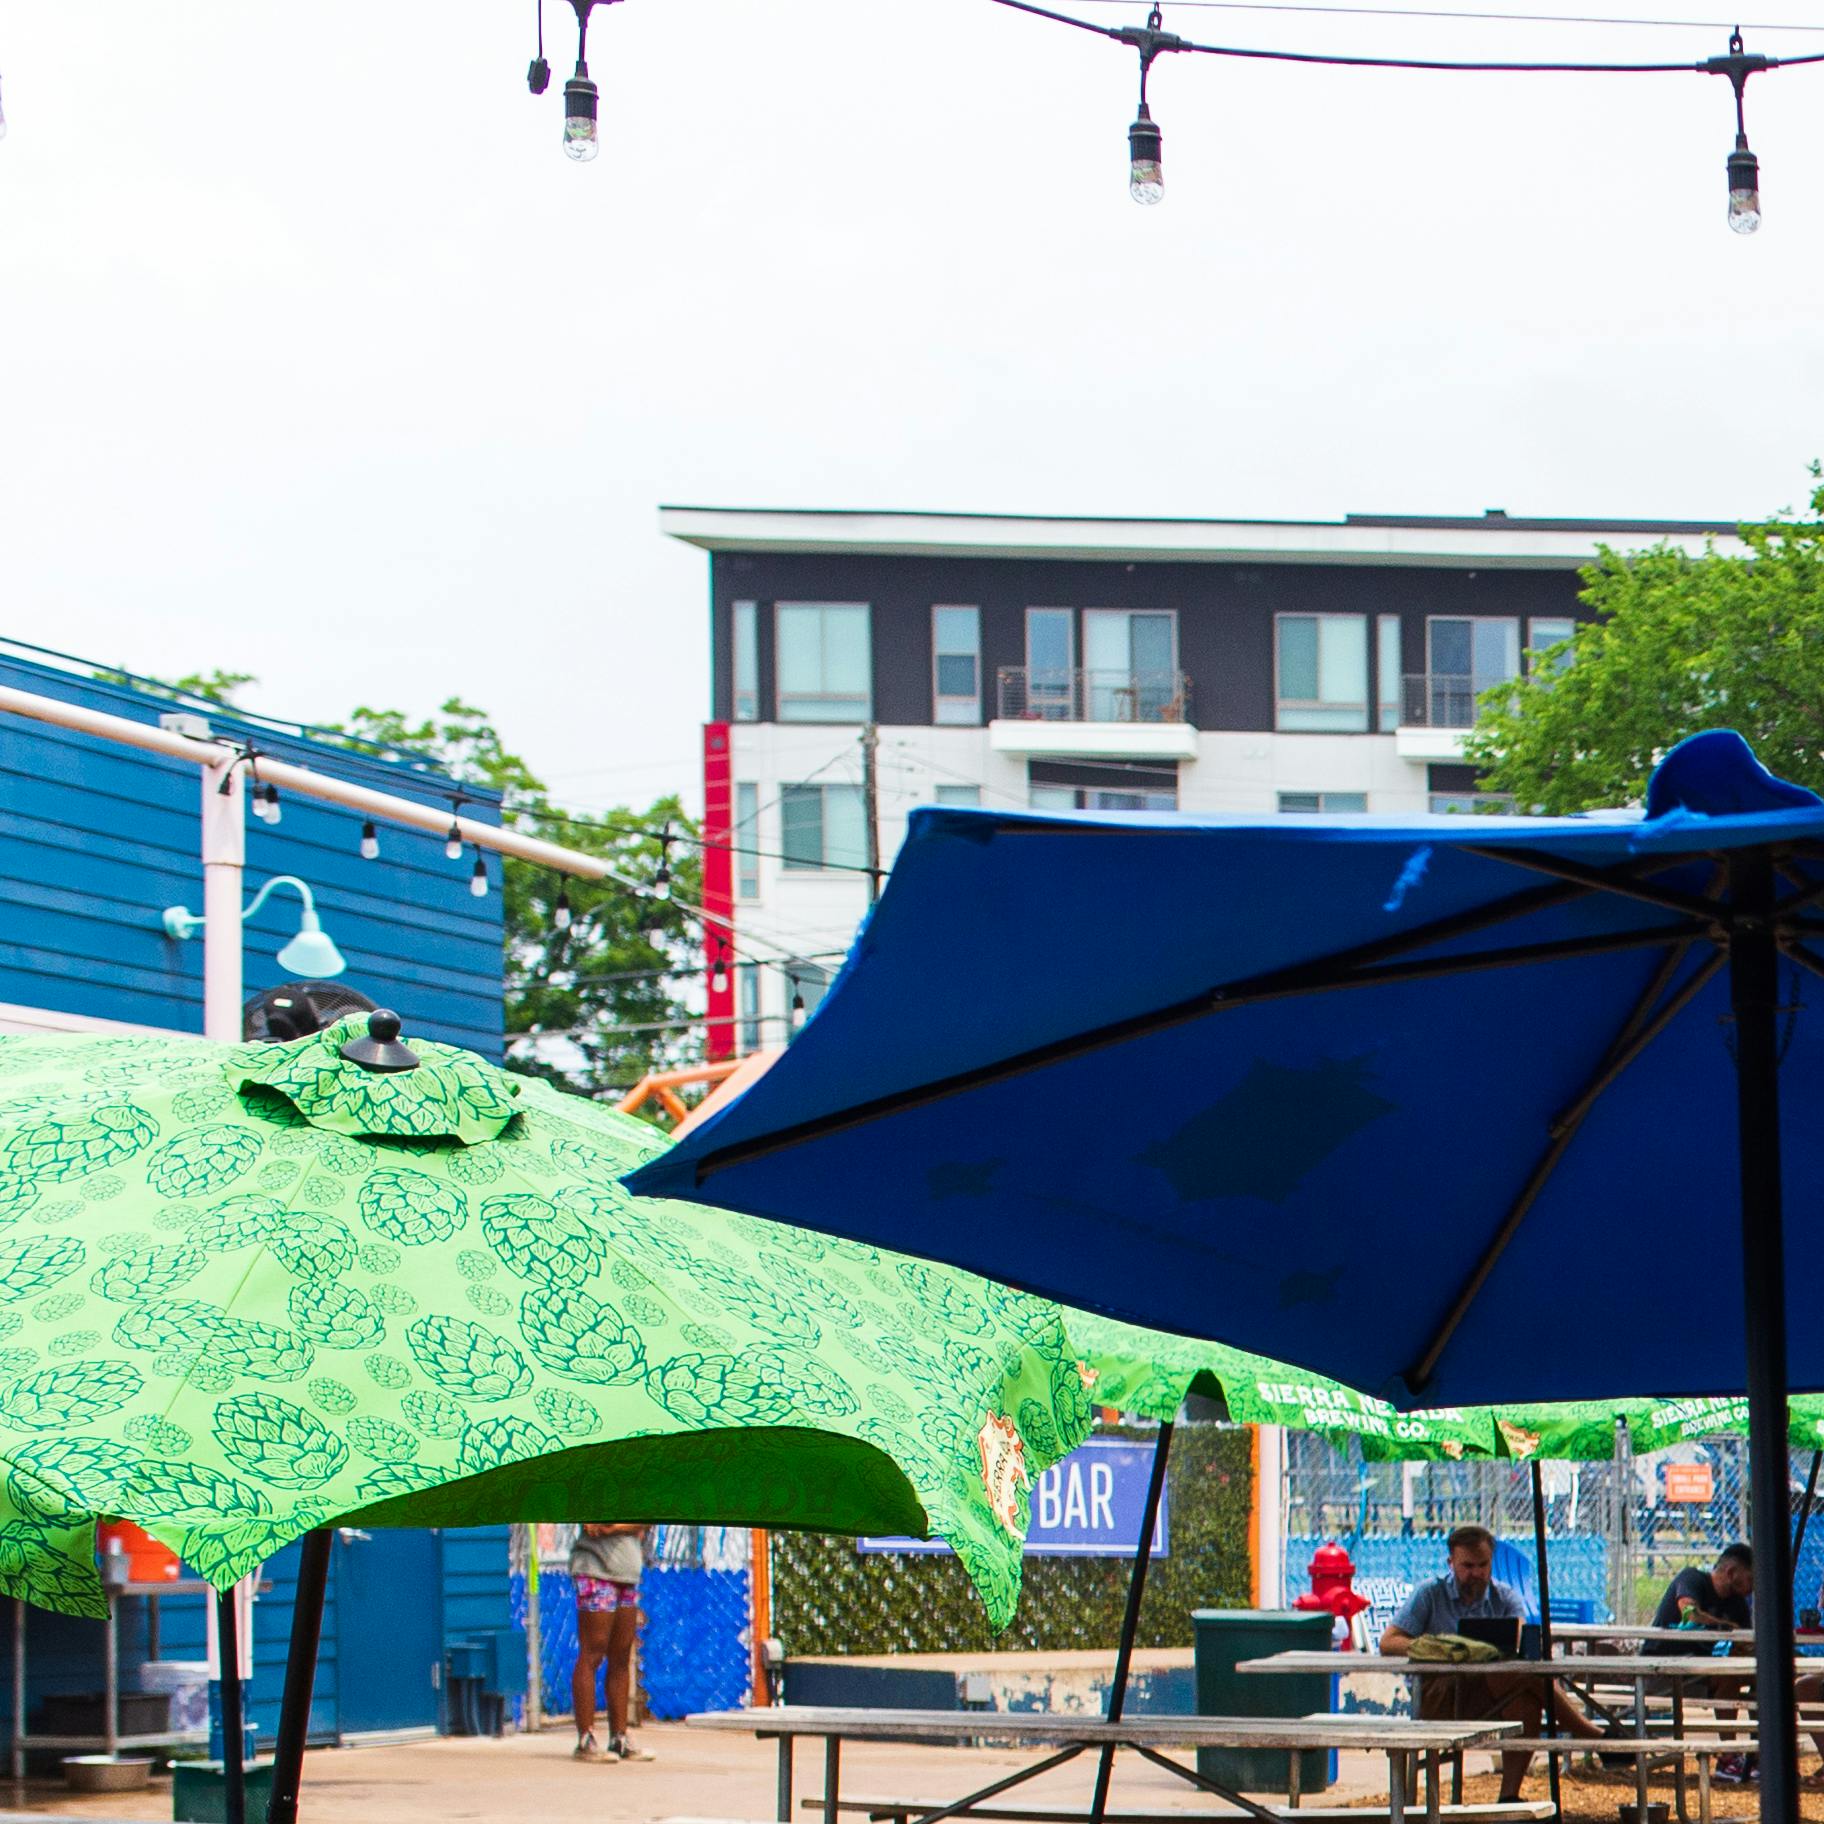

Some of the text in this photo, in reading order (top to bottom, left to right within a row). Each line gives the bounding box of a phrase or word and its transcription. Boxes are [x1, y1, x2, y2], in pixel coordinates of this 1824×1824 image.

[1259, 1384, 1463, 1422] SIERRA NEADA
[1652, 1400, 1705, 1428] SIERRA
[1397, 1422, 1430, 1439] CO.
[1040, 1462, 1115, 1529] BAR
